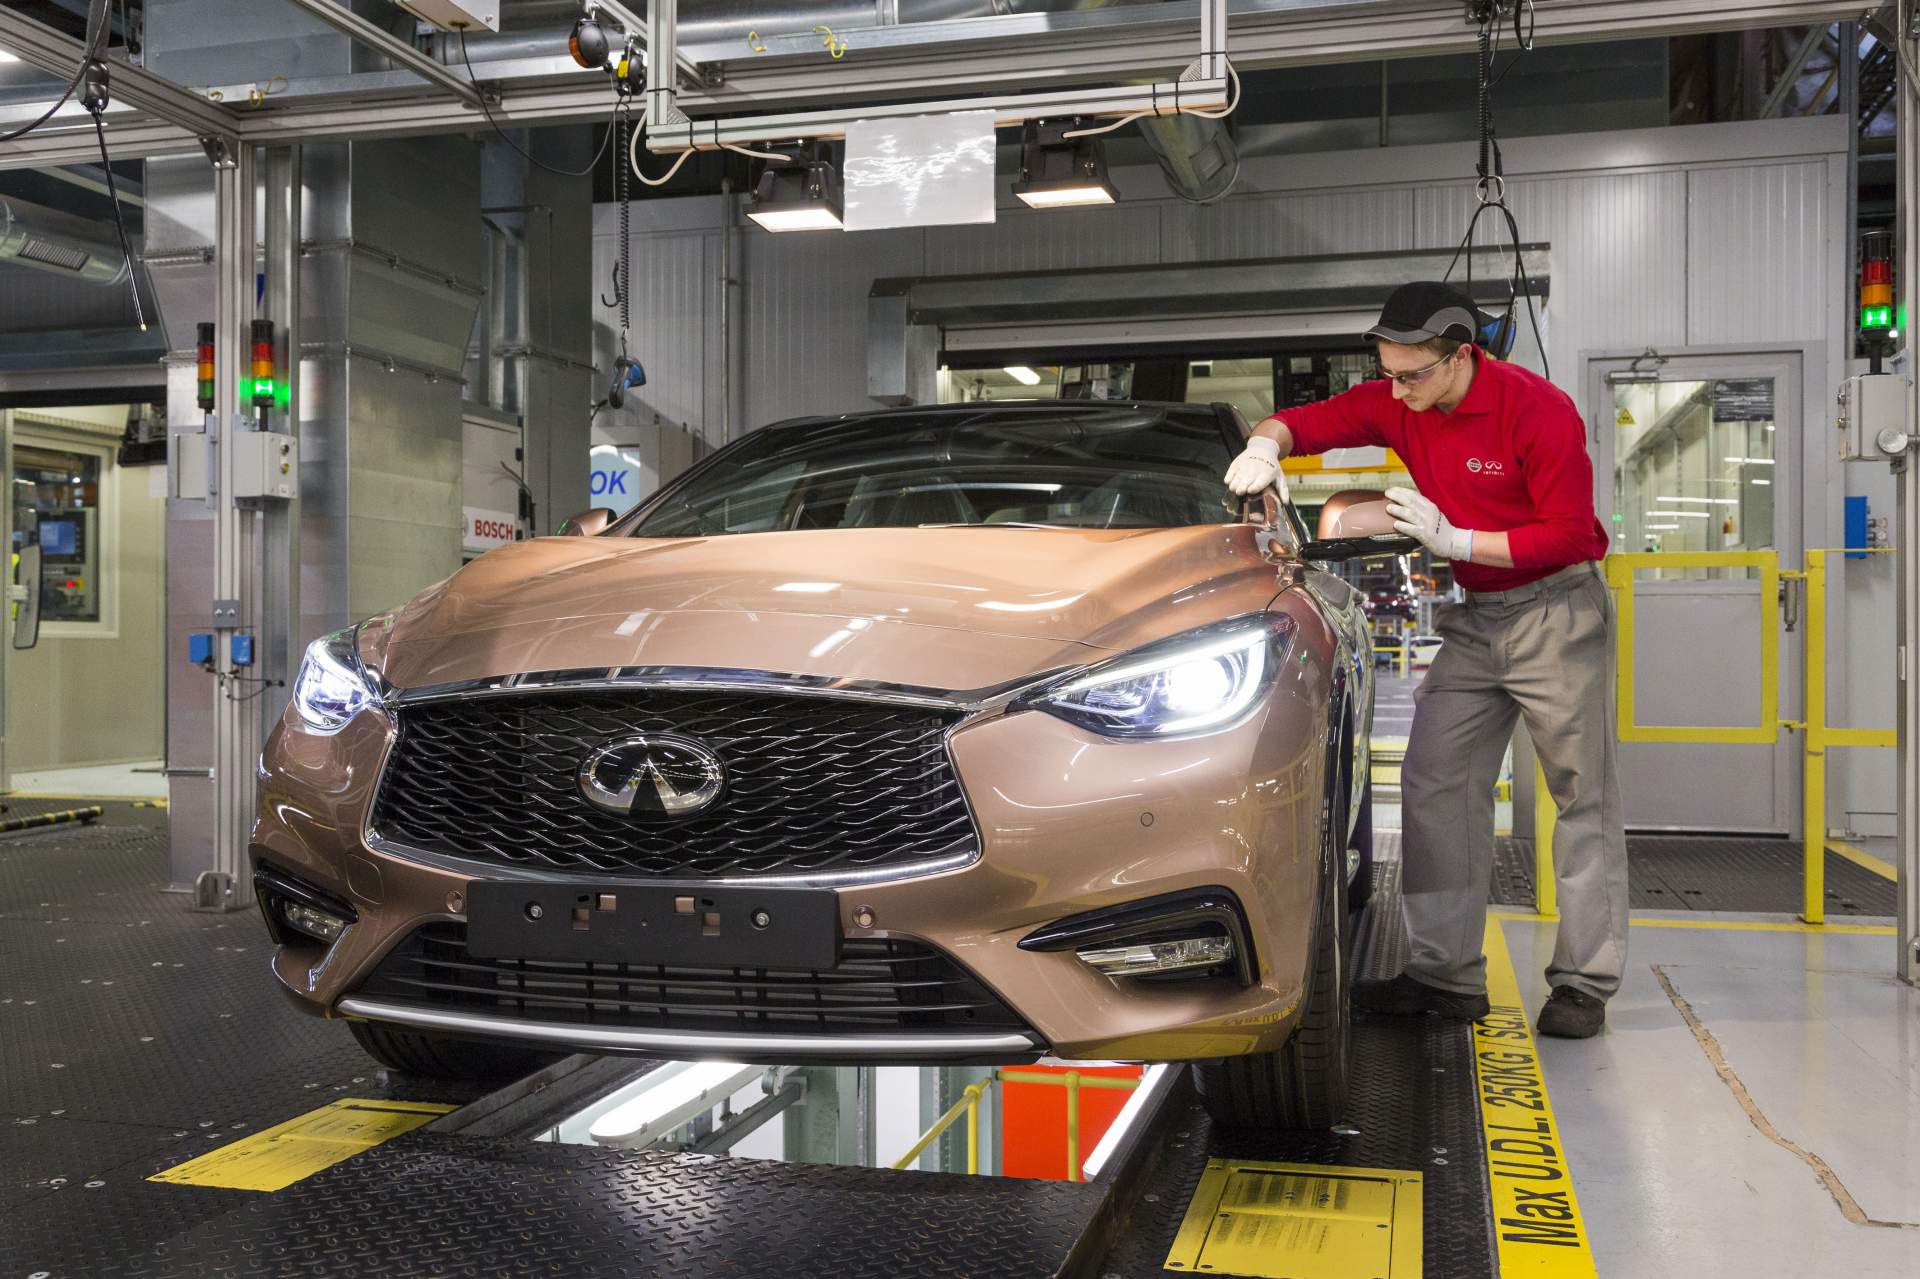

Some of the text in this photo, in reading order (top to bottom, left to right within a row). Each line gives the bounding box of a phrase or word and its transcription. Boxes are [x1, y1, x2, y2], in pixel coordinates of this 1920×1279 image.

[591, 470, 628, 495] OK
[475, 519, 514, 541] BOSCH
[1479, 1051, 1544, 1110] 250KG
[1488, 1117, 1563, 1180] U.D.L.
[1500, 1187, 1580, 1247] Max
